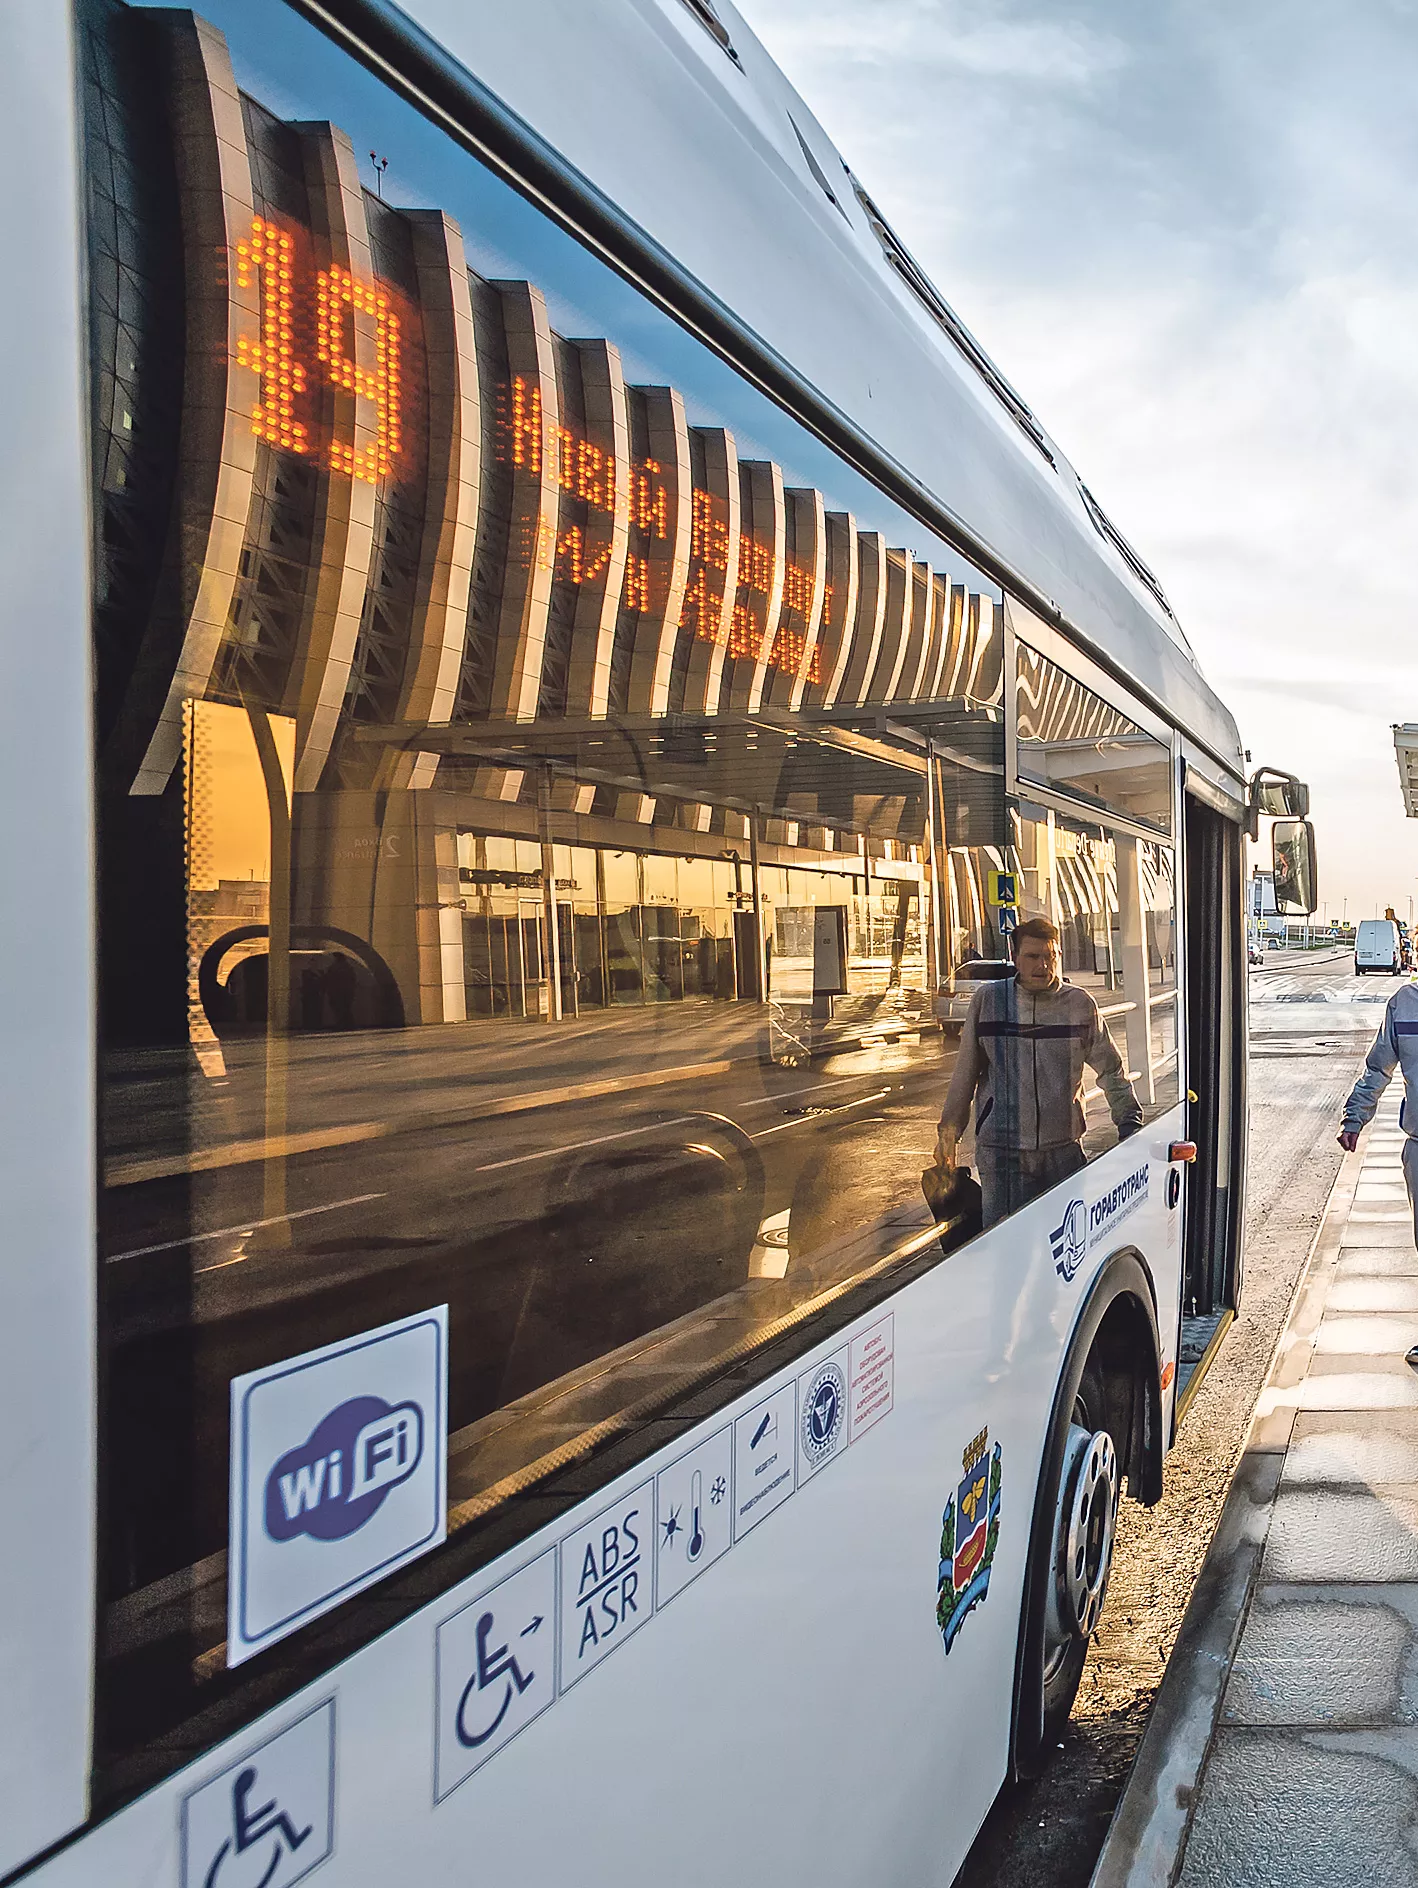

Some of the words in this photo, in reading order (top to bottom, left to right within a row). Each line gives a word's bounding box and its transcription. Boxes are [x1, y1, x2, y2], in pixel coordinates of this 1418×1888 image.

[235, 215, 401, 485] 19
[512, 376, 668, 540] Новый
[1088, 1163, 1149, 1232] ГОРАВТОТРАНС
[578, 1509, 639, 1595] ABS
[578, 1570, 638, 1659] ASR
